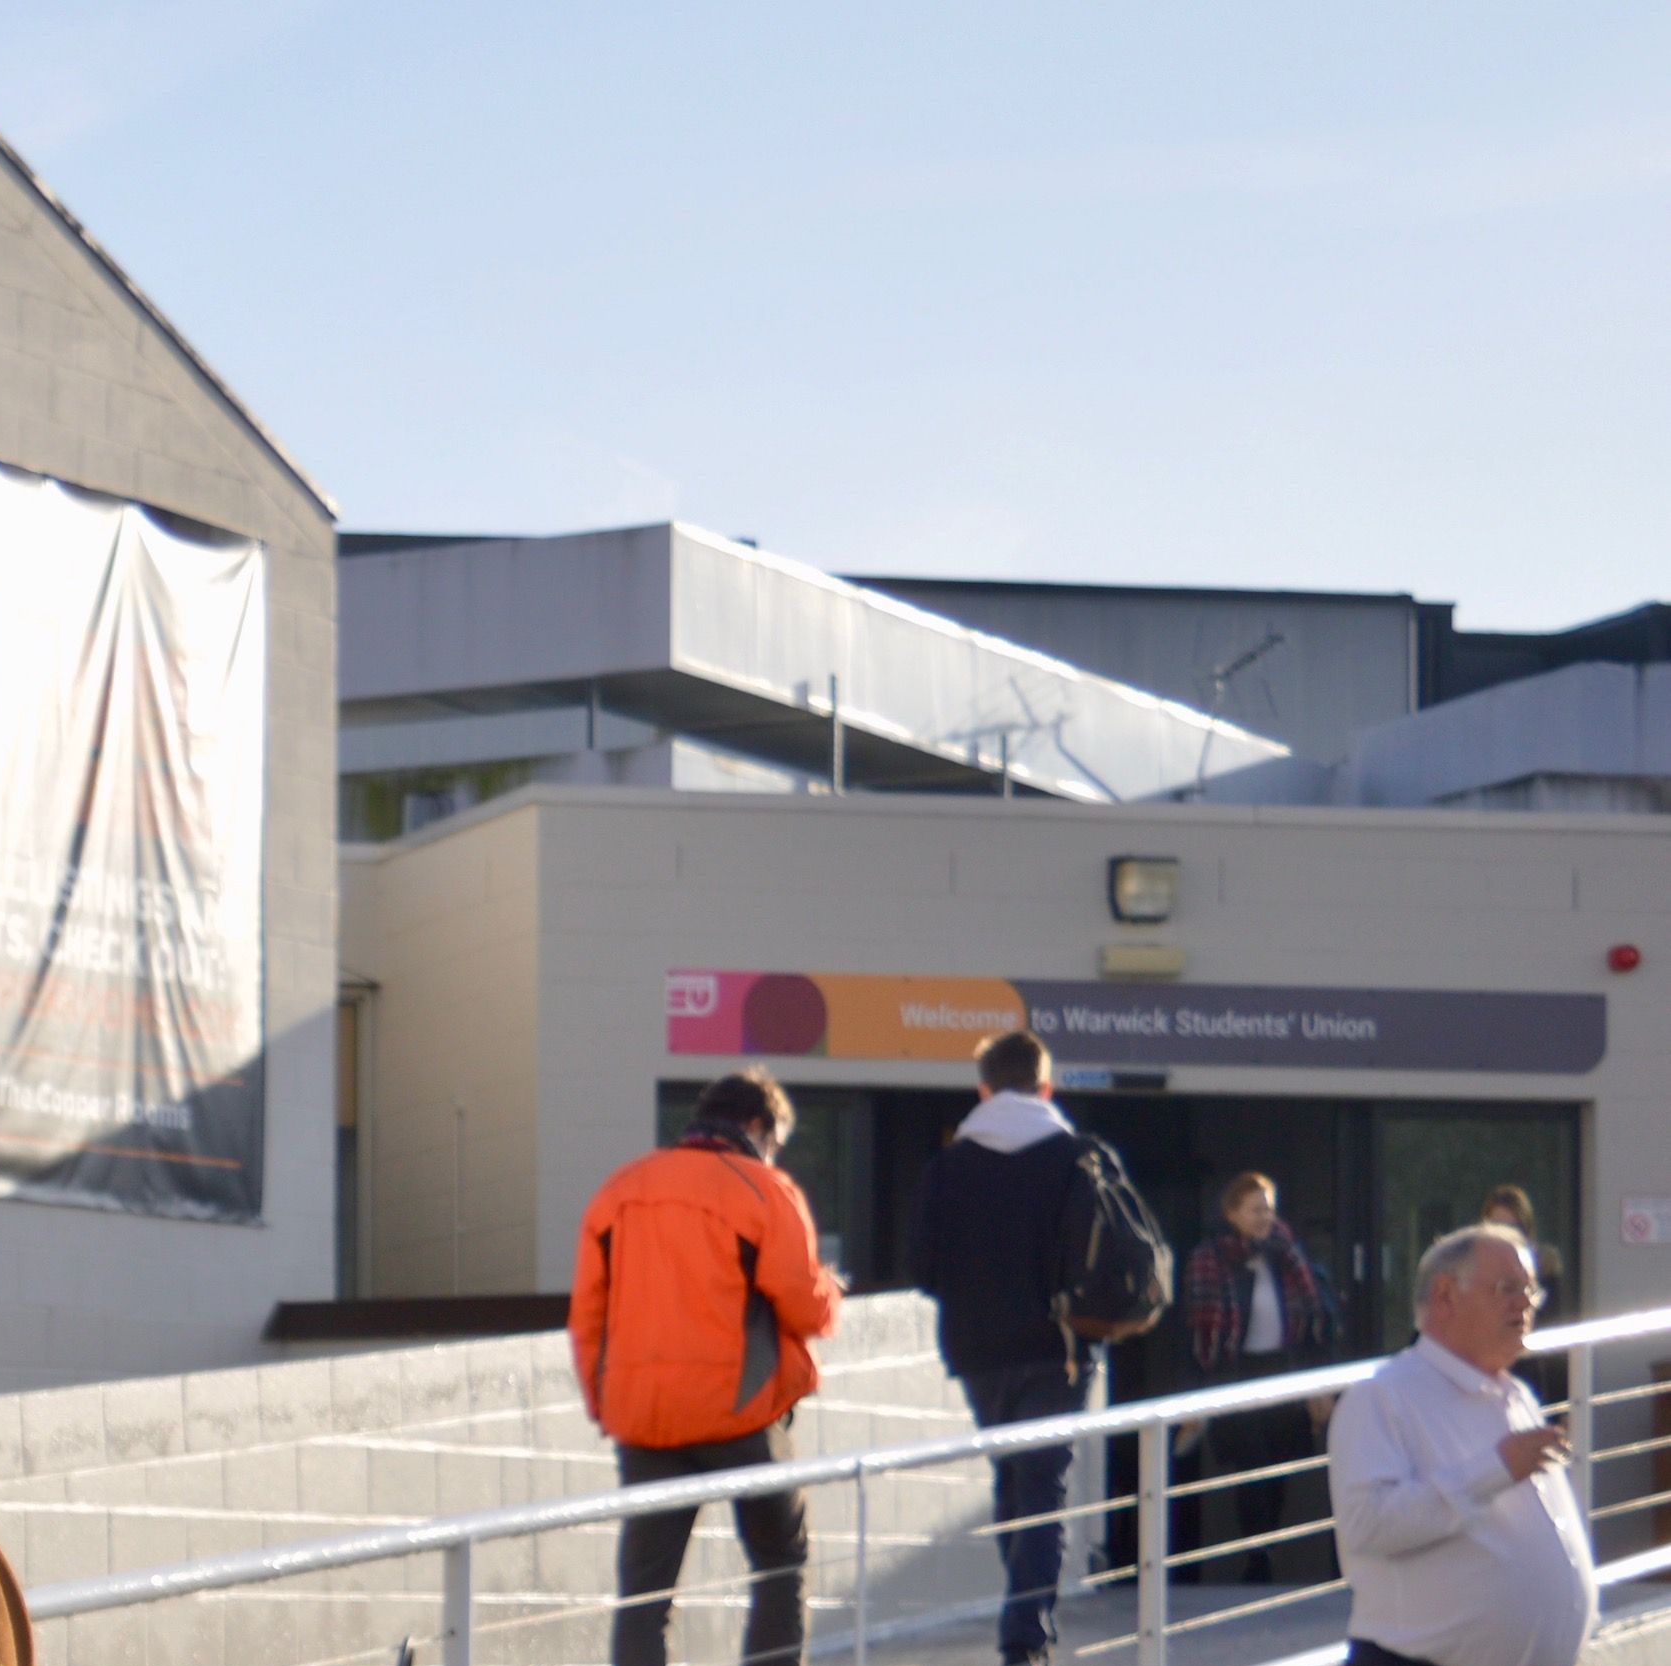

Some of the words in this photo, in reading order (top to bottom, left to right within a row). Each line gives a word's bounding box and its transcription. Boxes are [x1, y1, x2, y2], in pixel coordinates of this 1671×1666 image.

[899, 1001, 1018, 1031] Welcome
[1031, 1007, 1057, 1033] to
[1062, 1006, 1170, 1035] Warwick
[1301, 1012, 1377, 1041] Union
[0, 1076, 33, 1110] The
